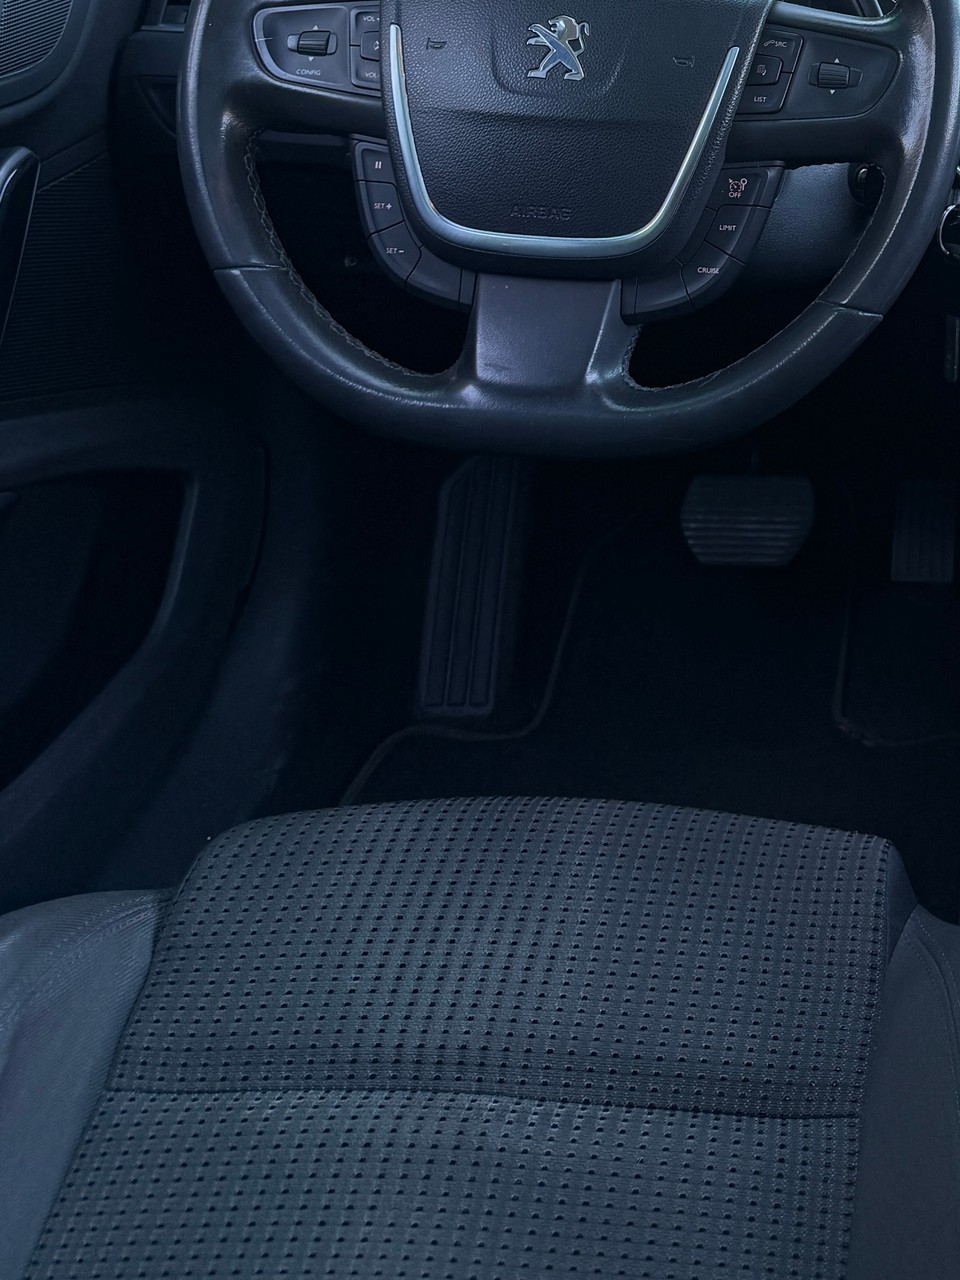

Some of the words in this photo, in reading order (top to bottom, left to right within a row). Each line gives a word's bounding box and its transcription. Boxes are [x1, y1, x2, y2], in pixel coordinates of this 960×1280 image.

[296, 68, 321, 76] CONFIG
[510, 205, 571, 221] AIRBAG
[697, 266, 720, 274] CRUISE
